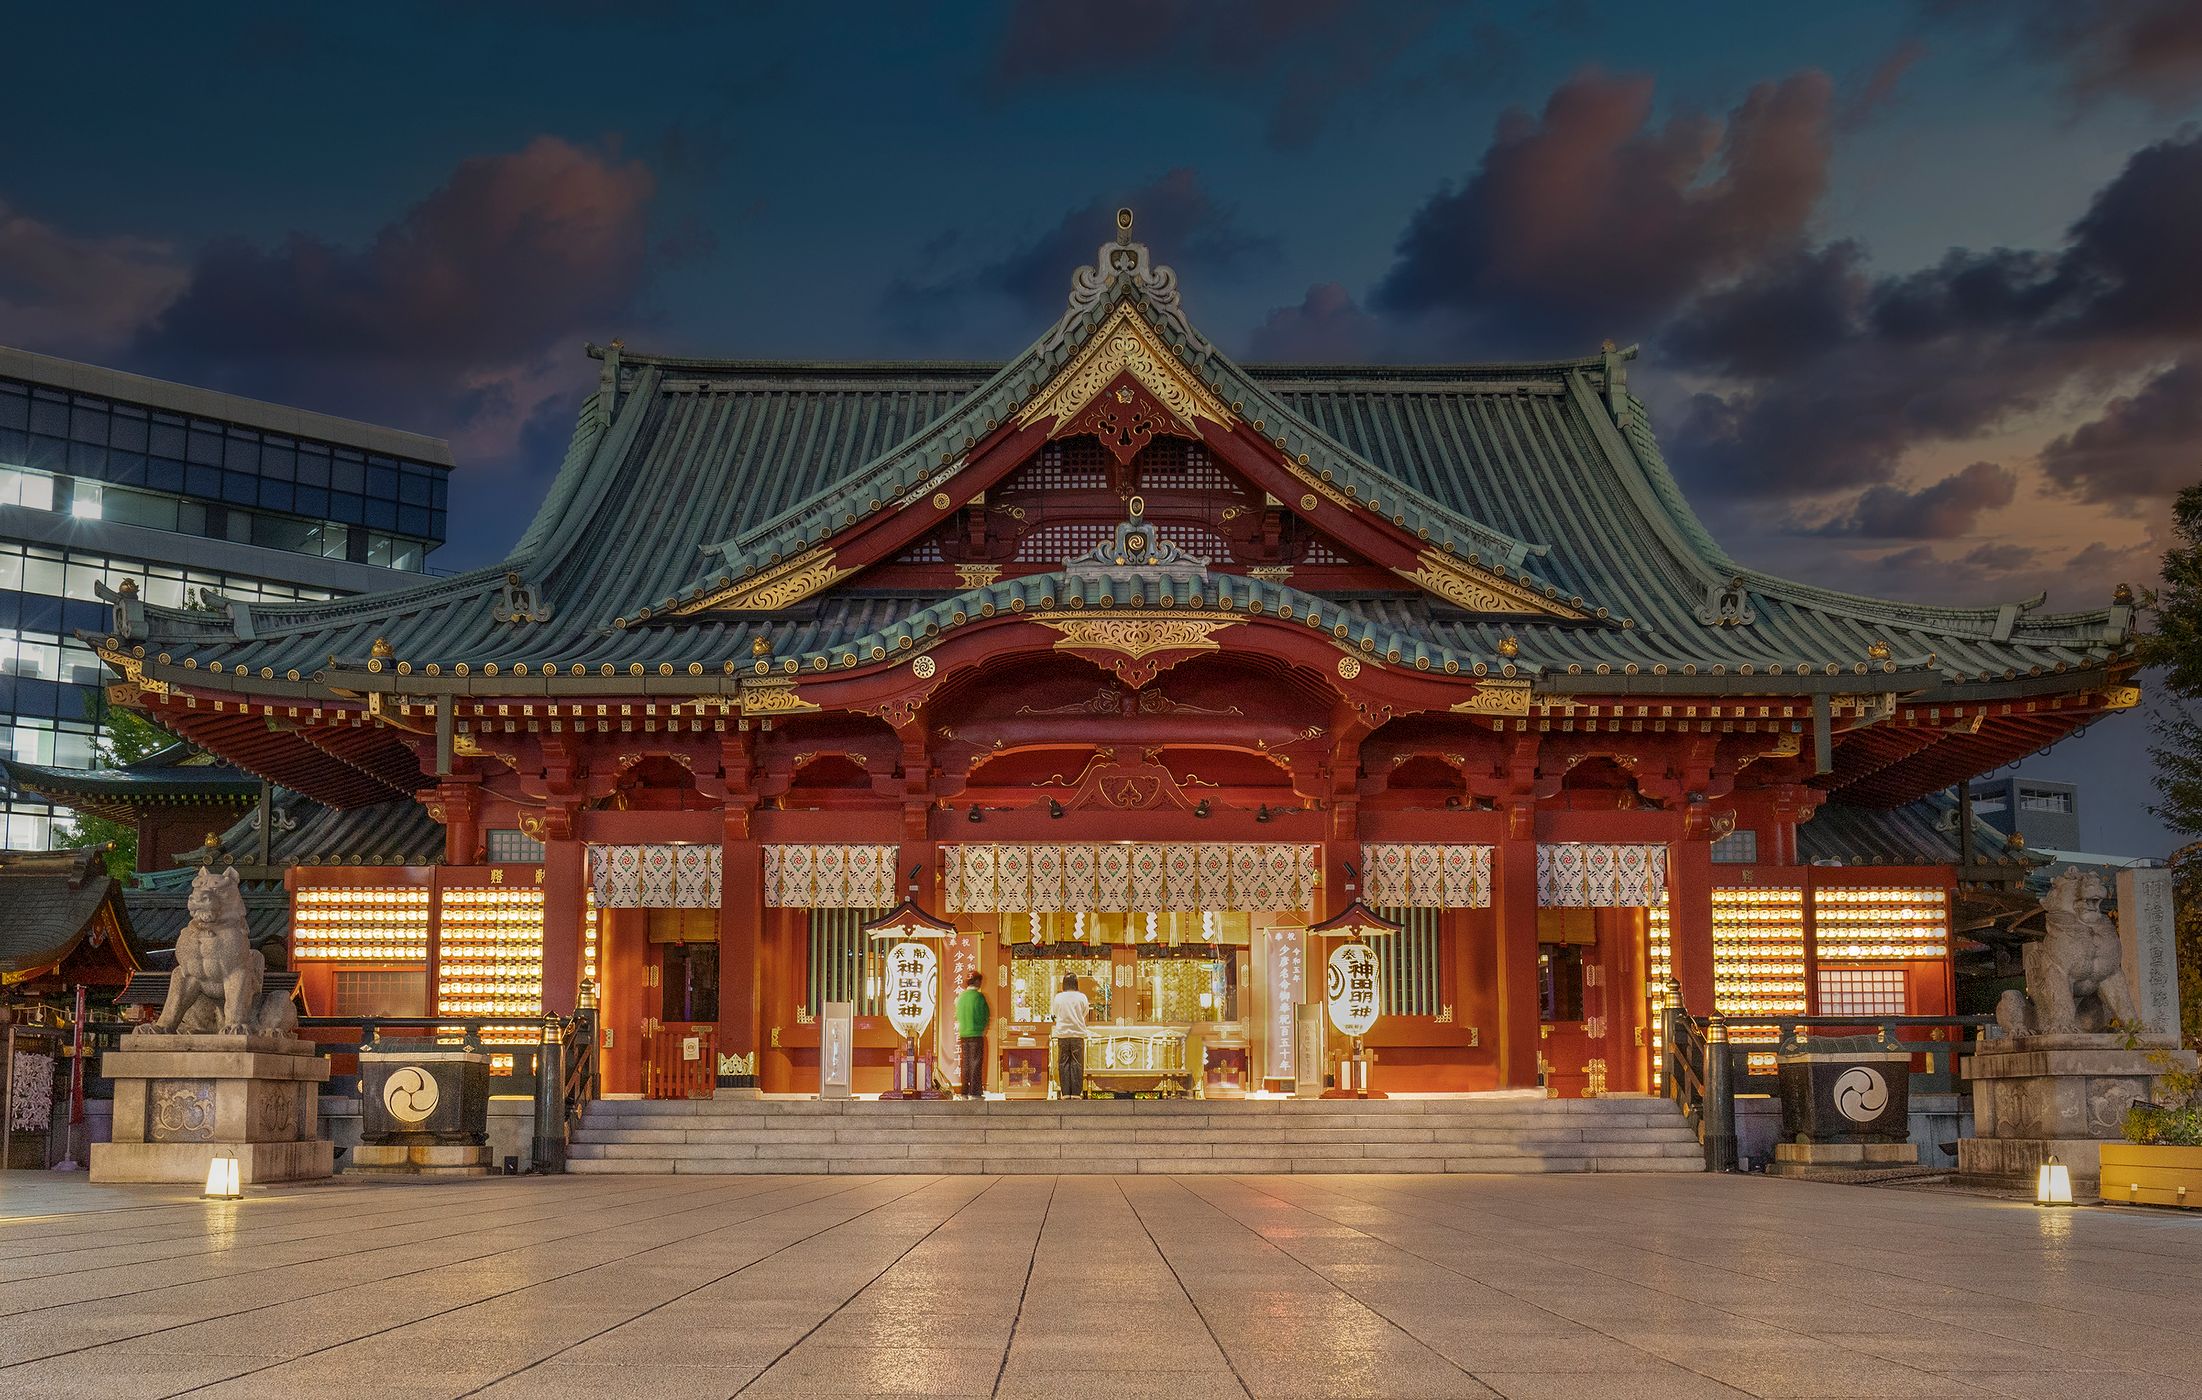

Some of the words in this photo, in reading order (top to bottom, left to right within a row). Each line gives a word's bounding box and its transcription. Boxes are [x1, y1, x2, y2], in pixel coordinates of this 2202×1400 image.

[897, 960, 924, 1018] 神田明神
[1348, 960, 1374, 1018] 神田明神
